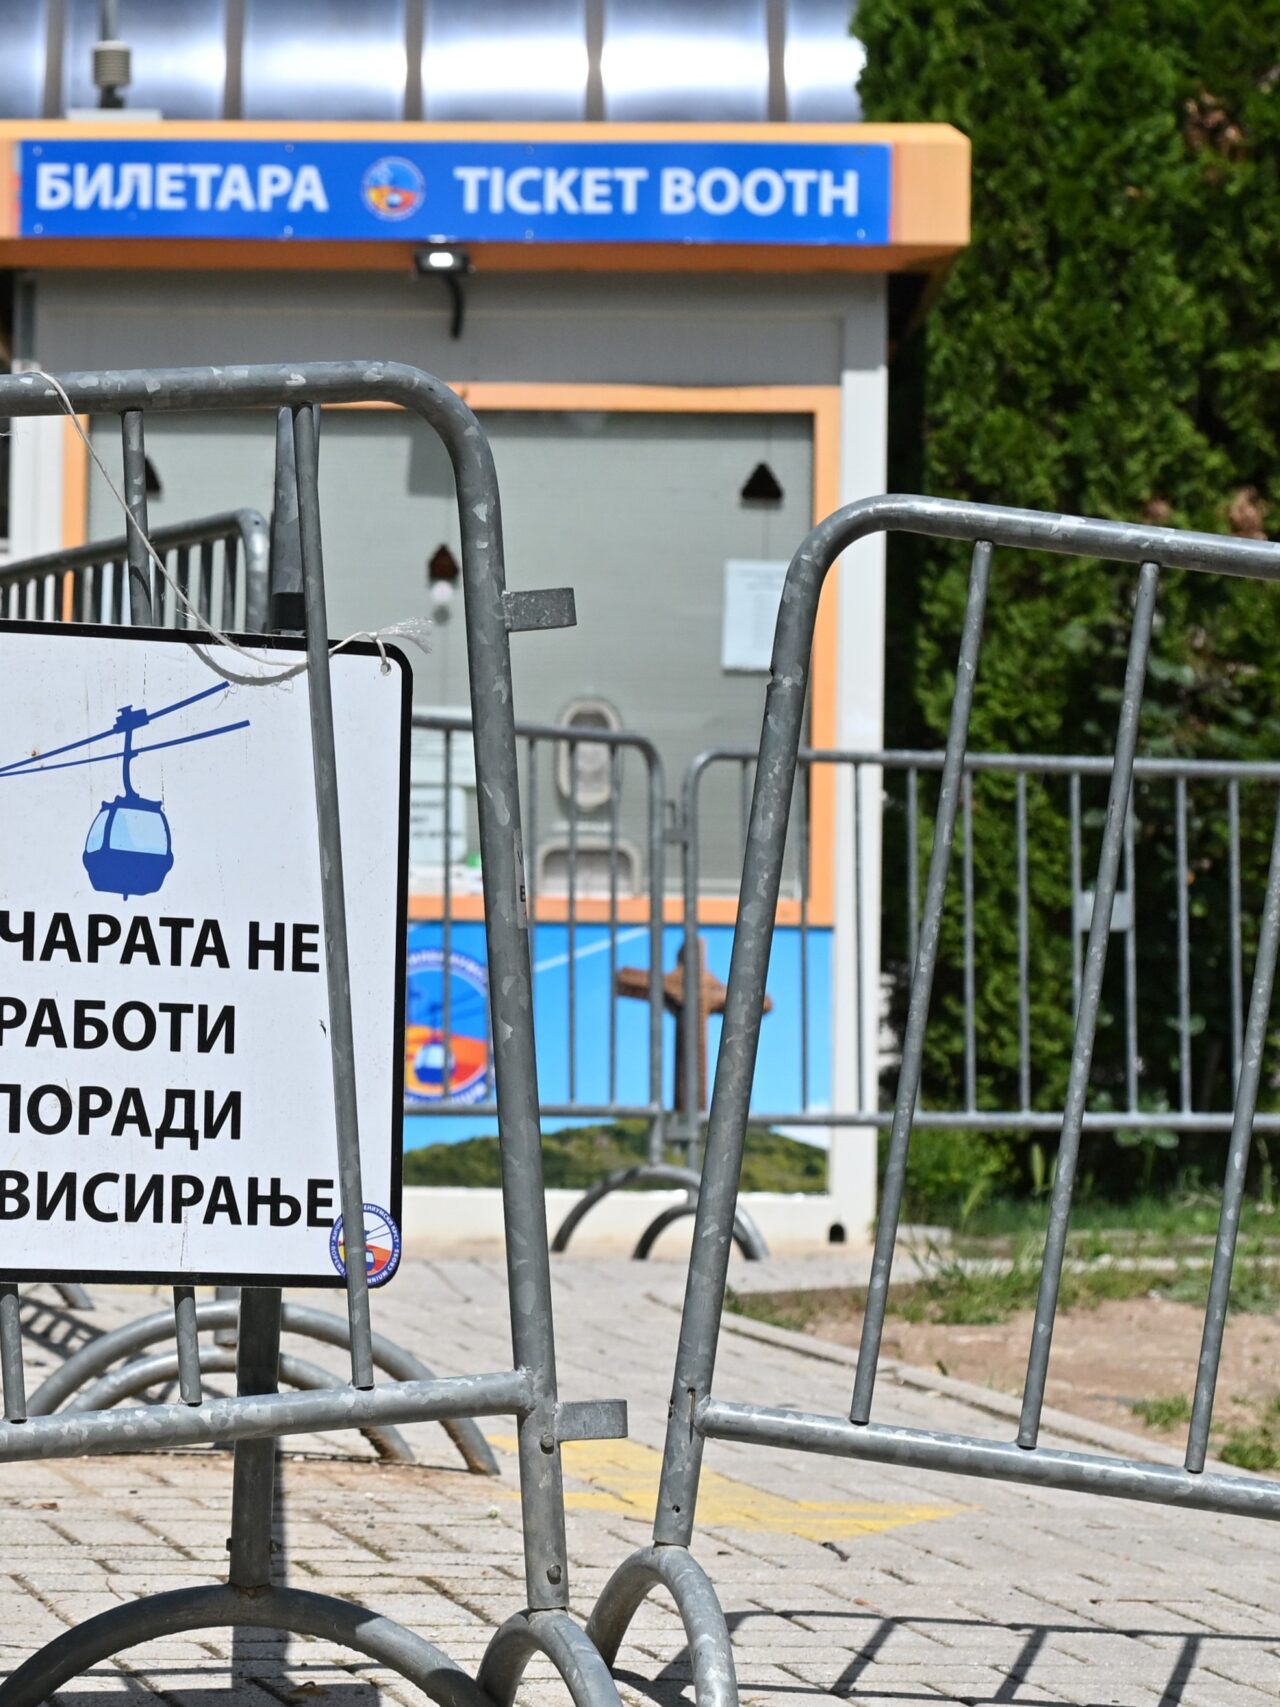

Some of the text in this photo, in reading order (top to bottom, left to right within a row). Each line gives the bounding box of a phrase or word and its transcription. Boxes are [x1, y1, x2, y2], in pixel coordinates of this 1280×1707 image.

[35, 162, 329, 212] БИЛЕТАРА
[454, 166, 648, 215] TICKET
[660, 168, 859, 217] BOOTH
[248, 921, 320, 973] НЕ
